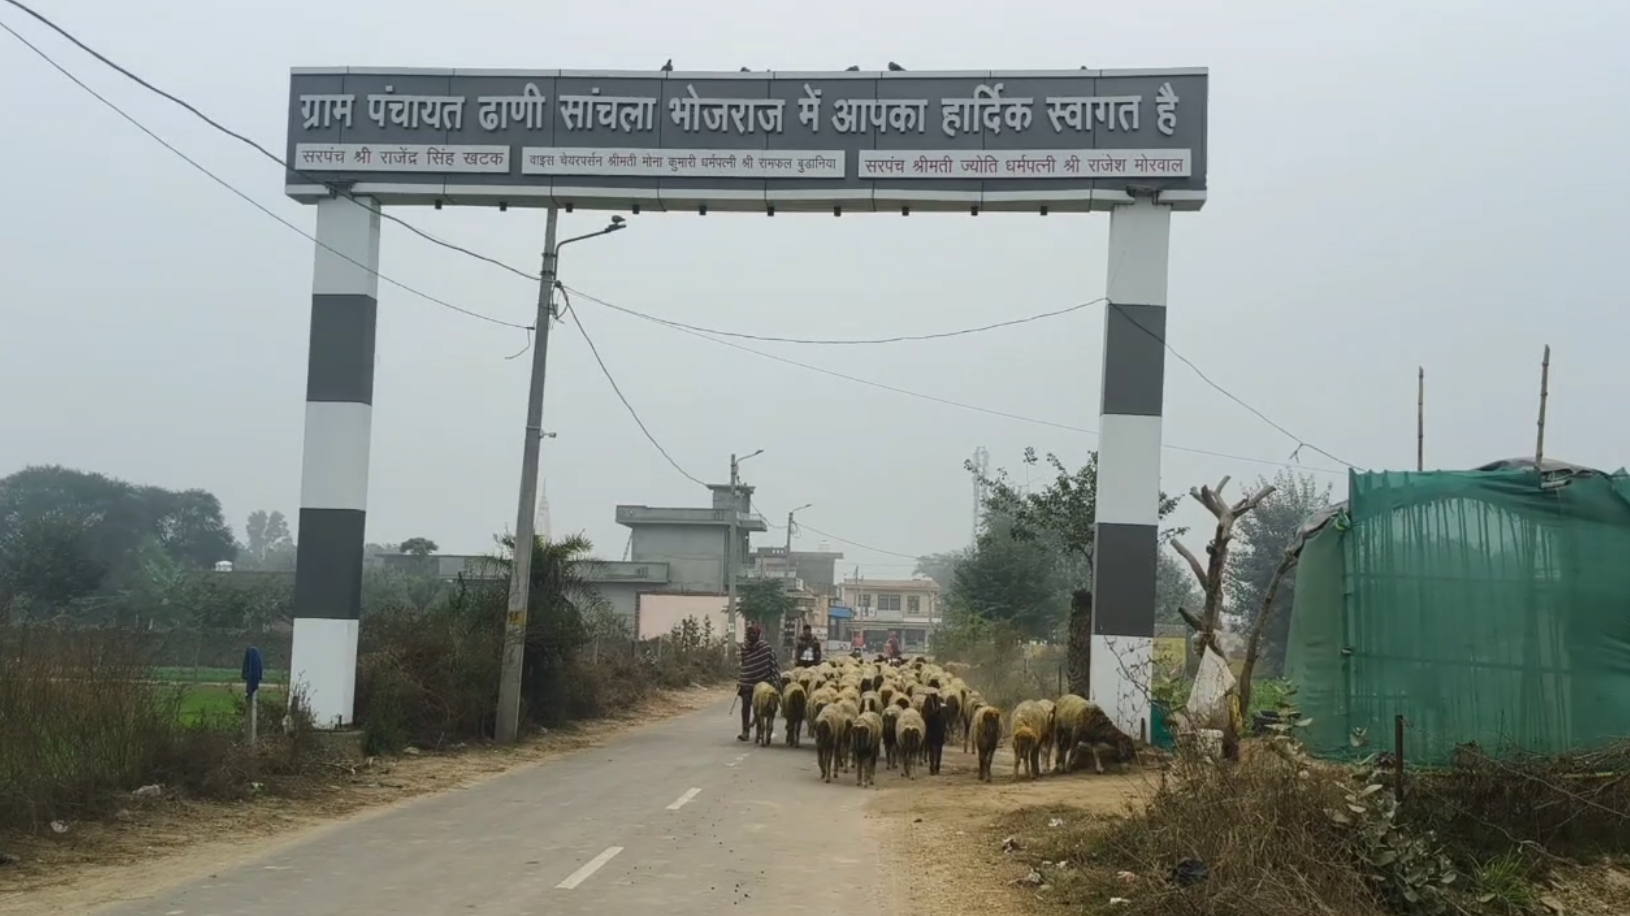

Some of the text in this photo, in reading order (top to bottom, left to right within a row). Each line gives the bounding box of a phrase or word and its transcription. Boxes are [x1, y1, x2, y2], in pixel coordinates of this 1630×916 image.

[300, 82, 1179, 136] ग्राम पंचायत ढाणी सांचला भोजराज में आपका हार्दिक स्वागत है
[302, 147, 504, 166] सरपंच श्री राजेंद्र सिंह खटक
[529, 154, 554, 167] वाइस
[608, 152, 637, 167] श्रीमती
[642, 153, 663, 168] मोना
[668, 154, 696, 171] कुमारी
[701, 154, 736, 169] धर्मपत्नी
[742, 154, 753, 169] श्री
[865, 154, 1184, 173] सरपंच श्रीमती ज्योति धर्मपत्नी श्री राजेश मोरवाल
